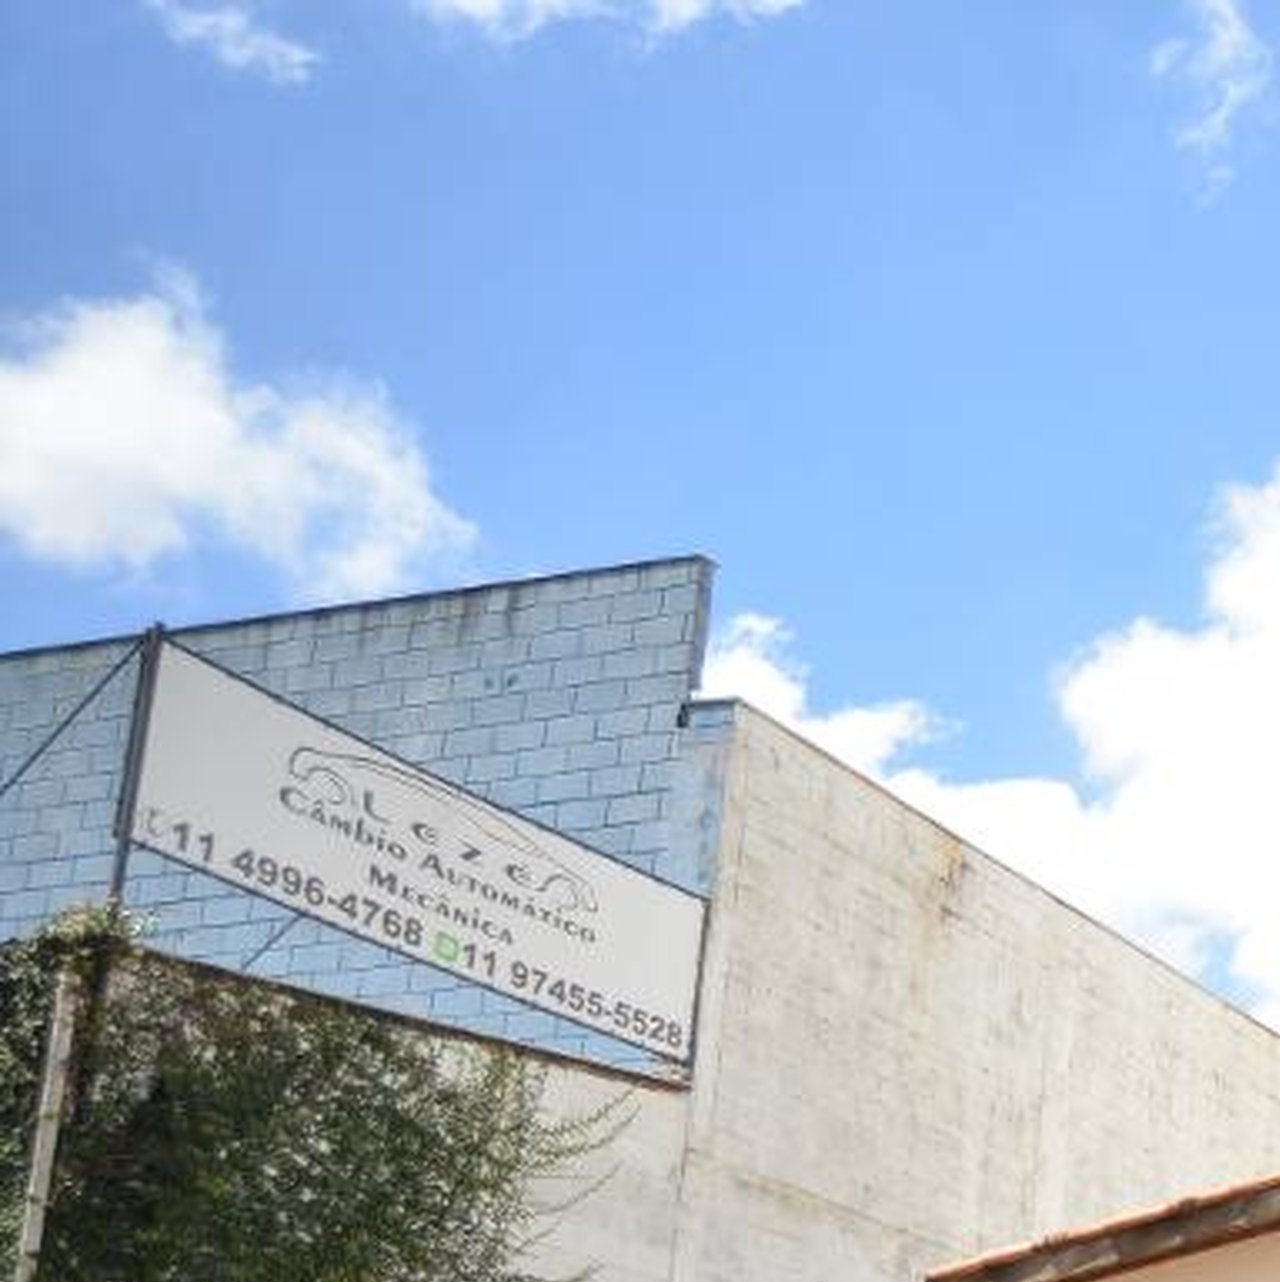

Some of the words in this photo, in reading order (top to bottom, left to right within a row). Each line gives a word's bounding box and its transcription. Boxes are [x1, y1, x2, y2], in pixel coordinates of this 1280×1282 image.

[172, 821, 215, 862] 11
[231, 849, 424, 948] 4996-4768
[463, 943, 497, 978] 11
[510, 960, 684, 1048] 97455-5528
